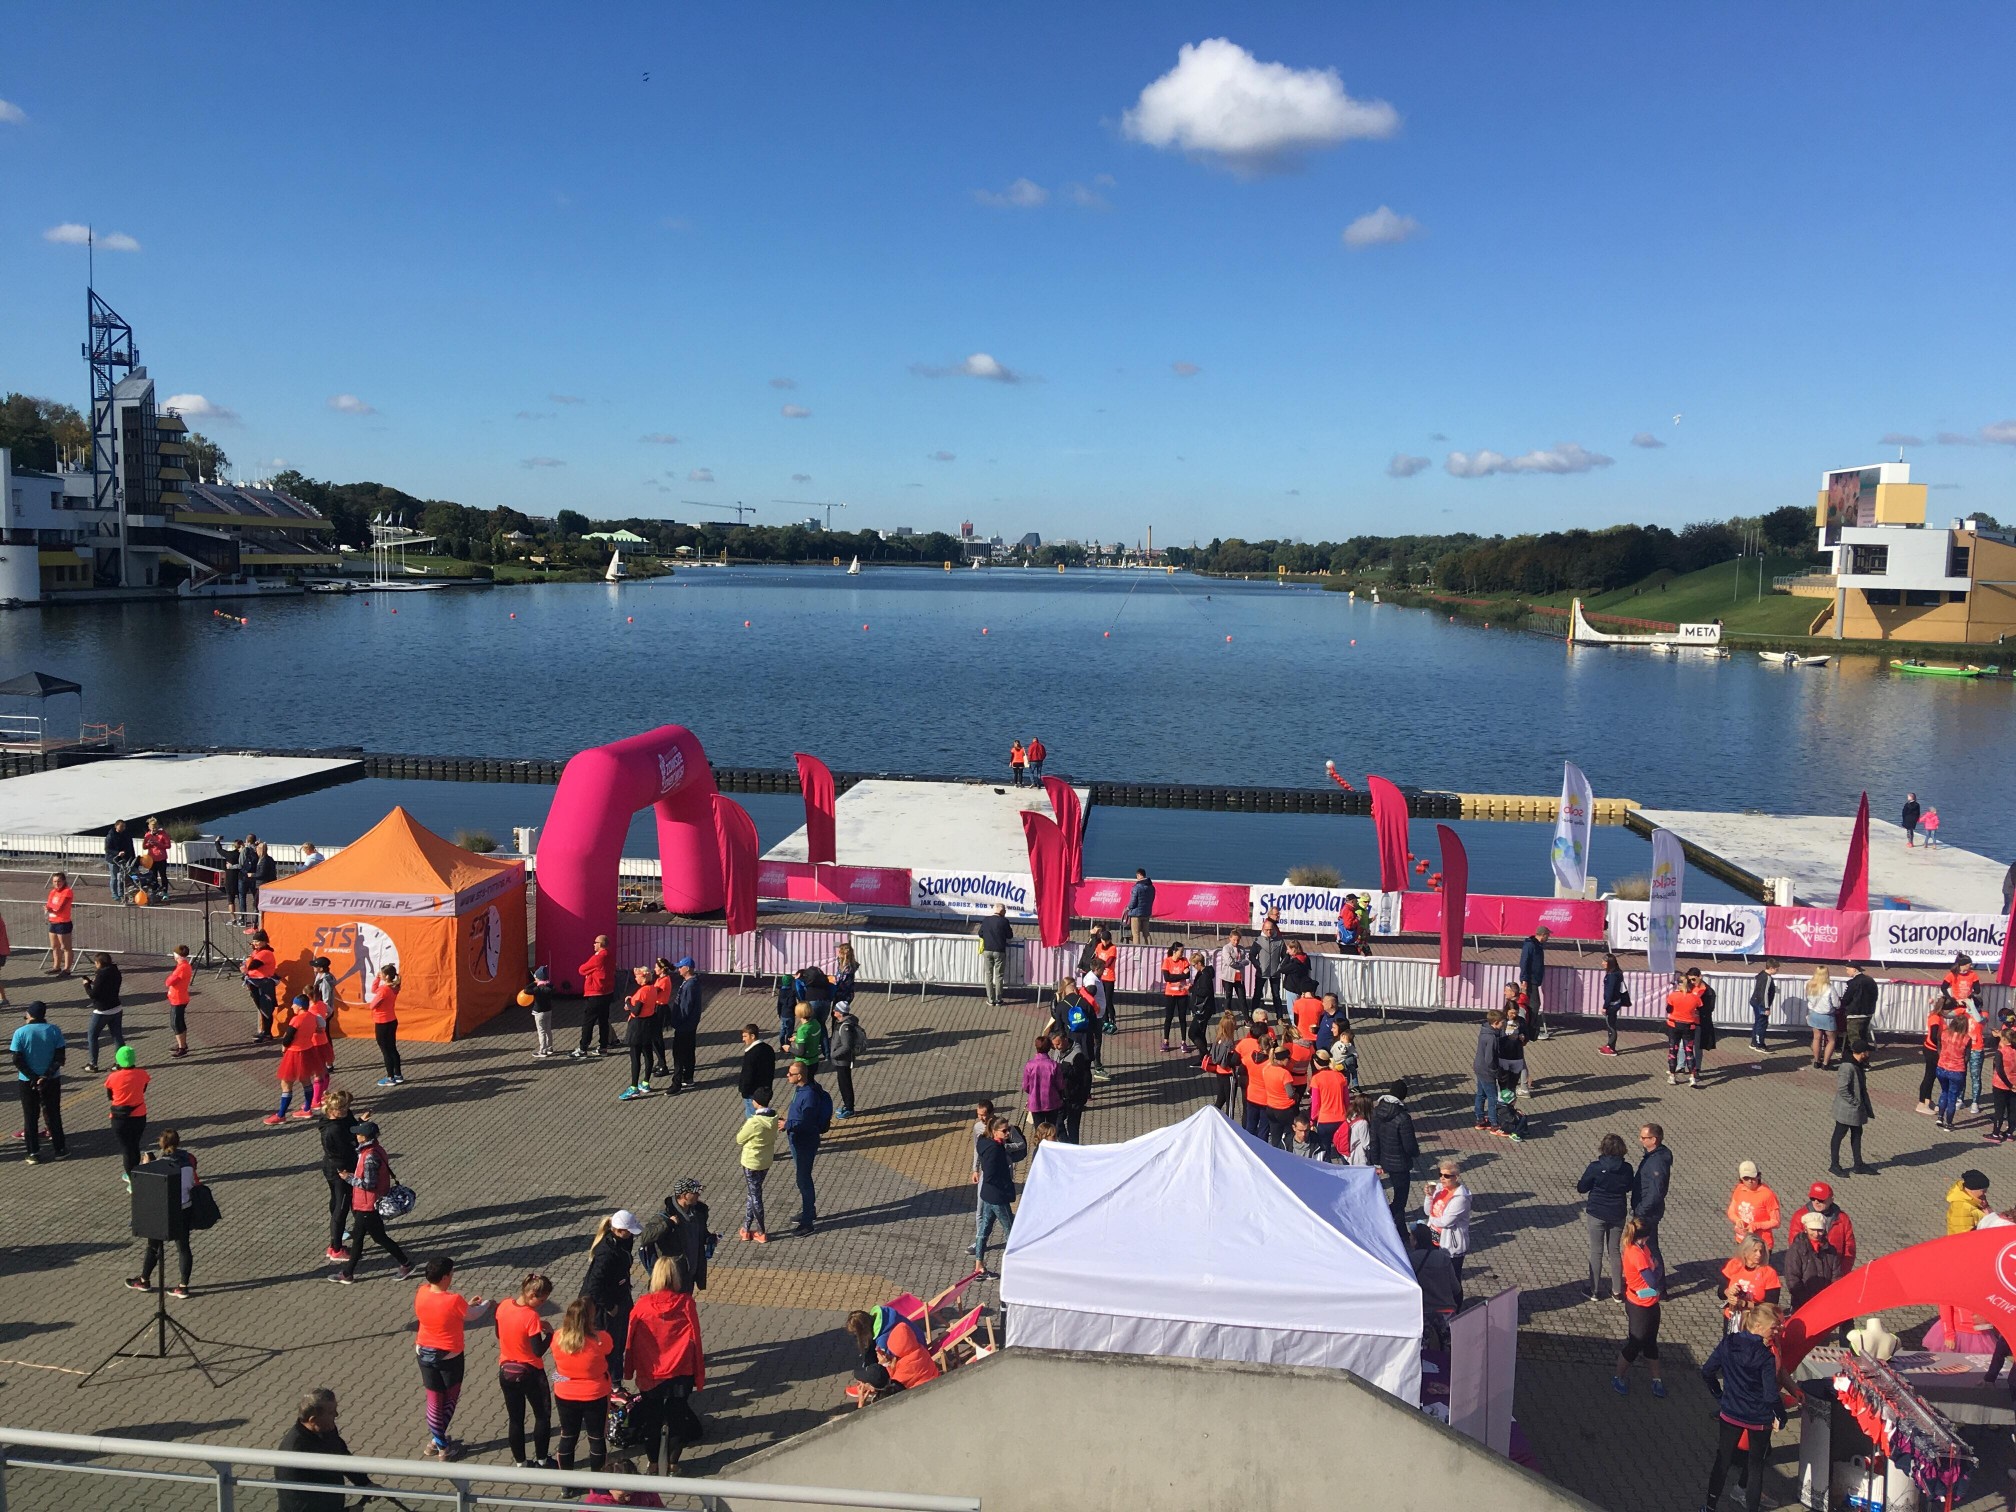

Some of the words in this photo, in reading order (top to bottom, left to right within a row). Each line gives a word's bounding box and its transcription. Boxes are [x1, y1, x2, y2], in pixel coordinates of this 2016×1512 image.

[1685, 627, 1716, 637] META
[918, 875, 1027, 904] Staropolanka
[312, 926, 355, 947] STS
[1686, 937, 1701, 945] RÓB
[1814, 934, 1838, 944] BIEGU
[1919, 948, 1947, 956] ROBISZ,
[1985, 1293, 2016, 1314] ACTIVE
